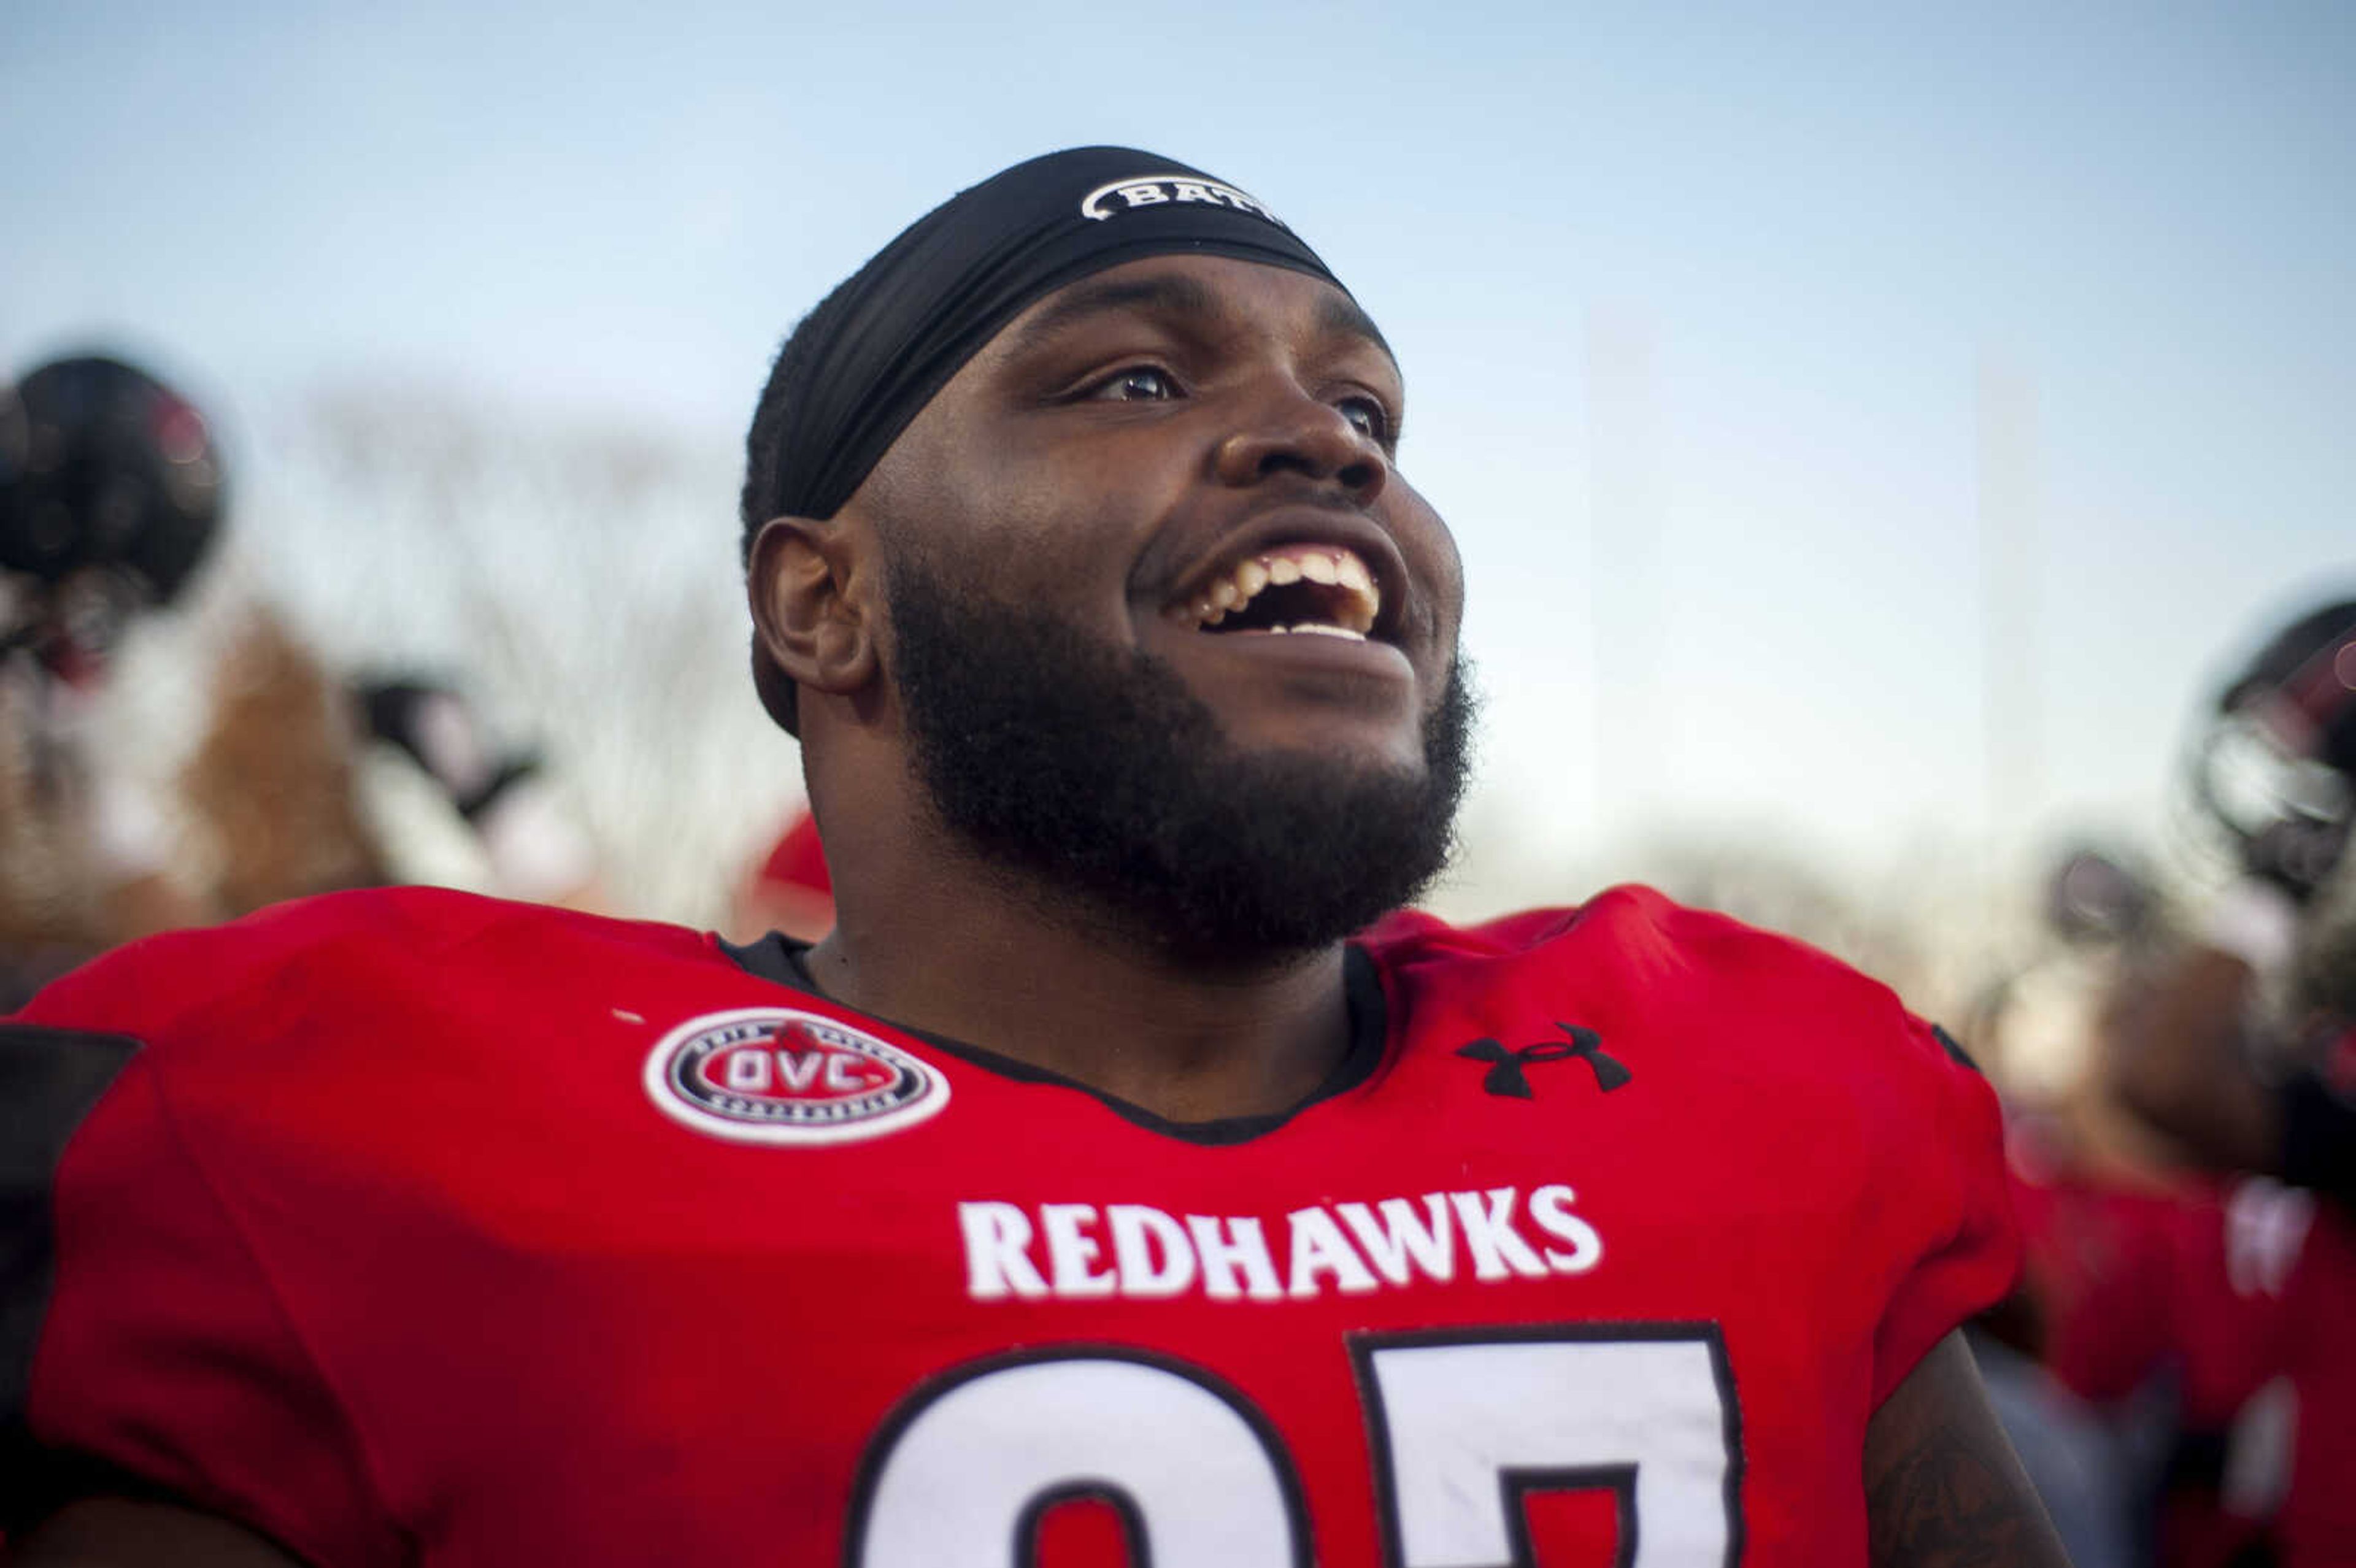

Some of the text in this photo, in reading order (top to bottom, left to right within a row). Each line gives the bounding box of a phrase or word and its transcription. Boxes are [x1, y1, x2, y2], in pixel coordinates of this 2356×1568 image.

[1117, 183, 1286, 225] BAT
[726, 1050, 866, 1091] OVC
[958, 1184, 1602, 1301] REDHAWKS
